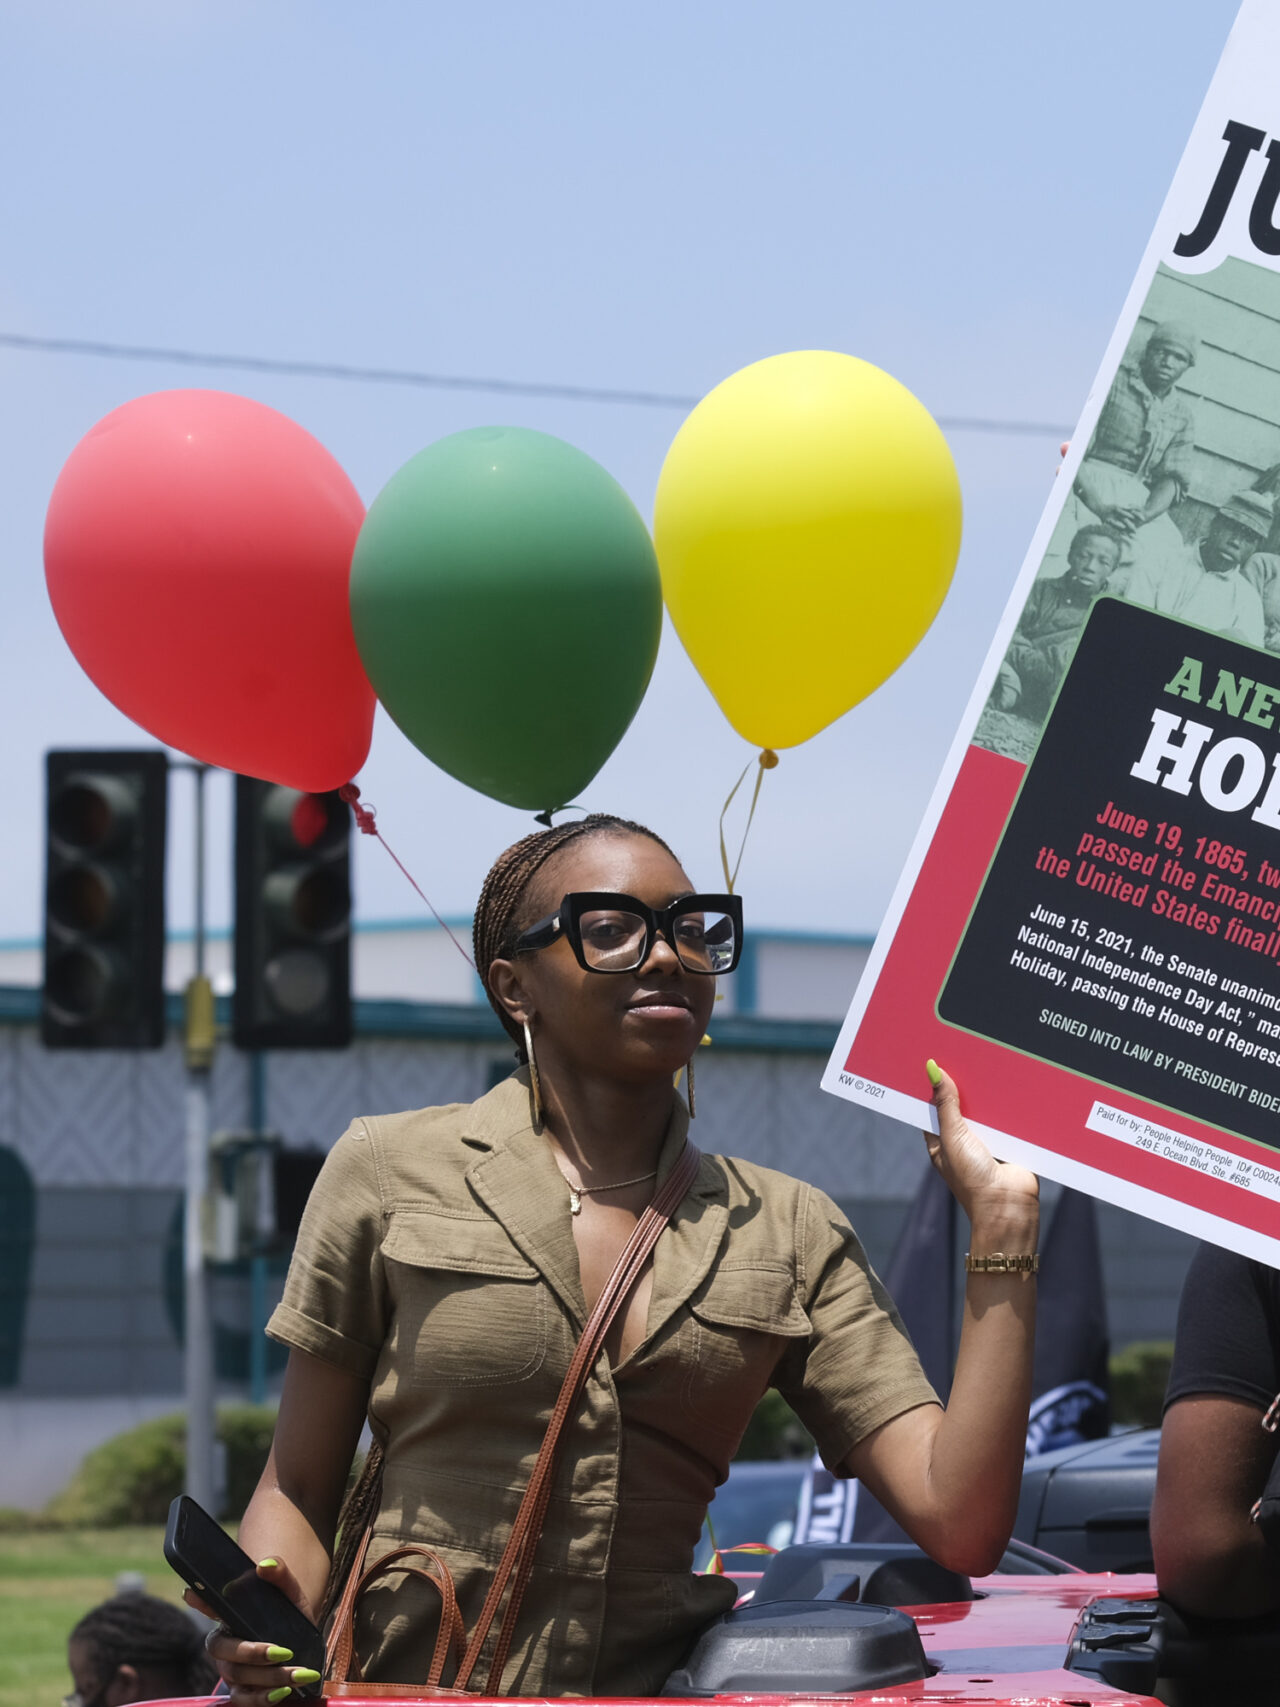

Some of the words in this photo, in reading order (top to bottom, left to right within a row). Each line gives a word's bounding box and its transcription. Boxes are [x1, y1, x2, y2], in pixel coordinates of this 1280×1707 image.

[1163, 656, 1202, 703] A
[1076, 833, 1158, 876] passed
[1160, 859, 1196, 890] the
[1096, 801, 1148, 838] June
[1155, 822, 1183, 856] 19,
[1194, 837, 1248, 881] 1865,
[1035, 847, 1070, 878] the
[1075, 860, 1149, 907] United
[1151, 889, 1220, 934] States
[1017, 925, 1080, 961] National
[1081, 949, 1181, 1000] Independence
[1184, 988, 1214, 1015] Day
[1030, 904, 1065, 928] June
[1070, 918, 1089, 941] 15,
[1095, 928, 1134, 958] 2021,
[1140, 945, 1164, 966] the
[1167, 955, 1217, 986] Senate
[1010, 949, 1066, 987] Holiday,
[1071, 976, 1129, 1010] passing
[1131, 996, 1155, 1017] the
[1158, 1006, 1204, 1036] House
[1207, 1028, 1224, 1043] of
[838, 1073, 854, 1086] KW
[864, 1084, 885, 1098] 2021
[1039, 1009, 1087, 1037] SIGNED
[1089, 1028, 1121, 1050] INTO
[1122, 1040, 1153, 1062] LAW
[1153, 1052, 1173, 1070] BY
[1174, 1060, 1247, 1098] PRESIDENT
[1096, 1106, 1115, 1121] Paid
[1116, 1114, 1128, 1125] for
[1143, 1124, 1171, 1143] People
[1172, 1136, 1203, 1157] Helping
[1204, 1148, 1232, 1166] People
[1236, 1161, 1252, 1173] ID#
[1135, 1135, 1152, 1149] 249
[1163, 1146, 1188, 1163] Ocean
[1189, 1156, 1208, 1171] Blvd.
[1229, 1173, 1250, 1187] #685
